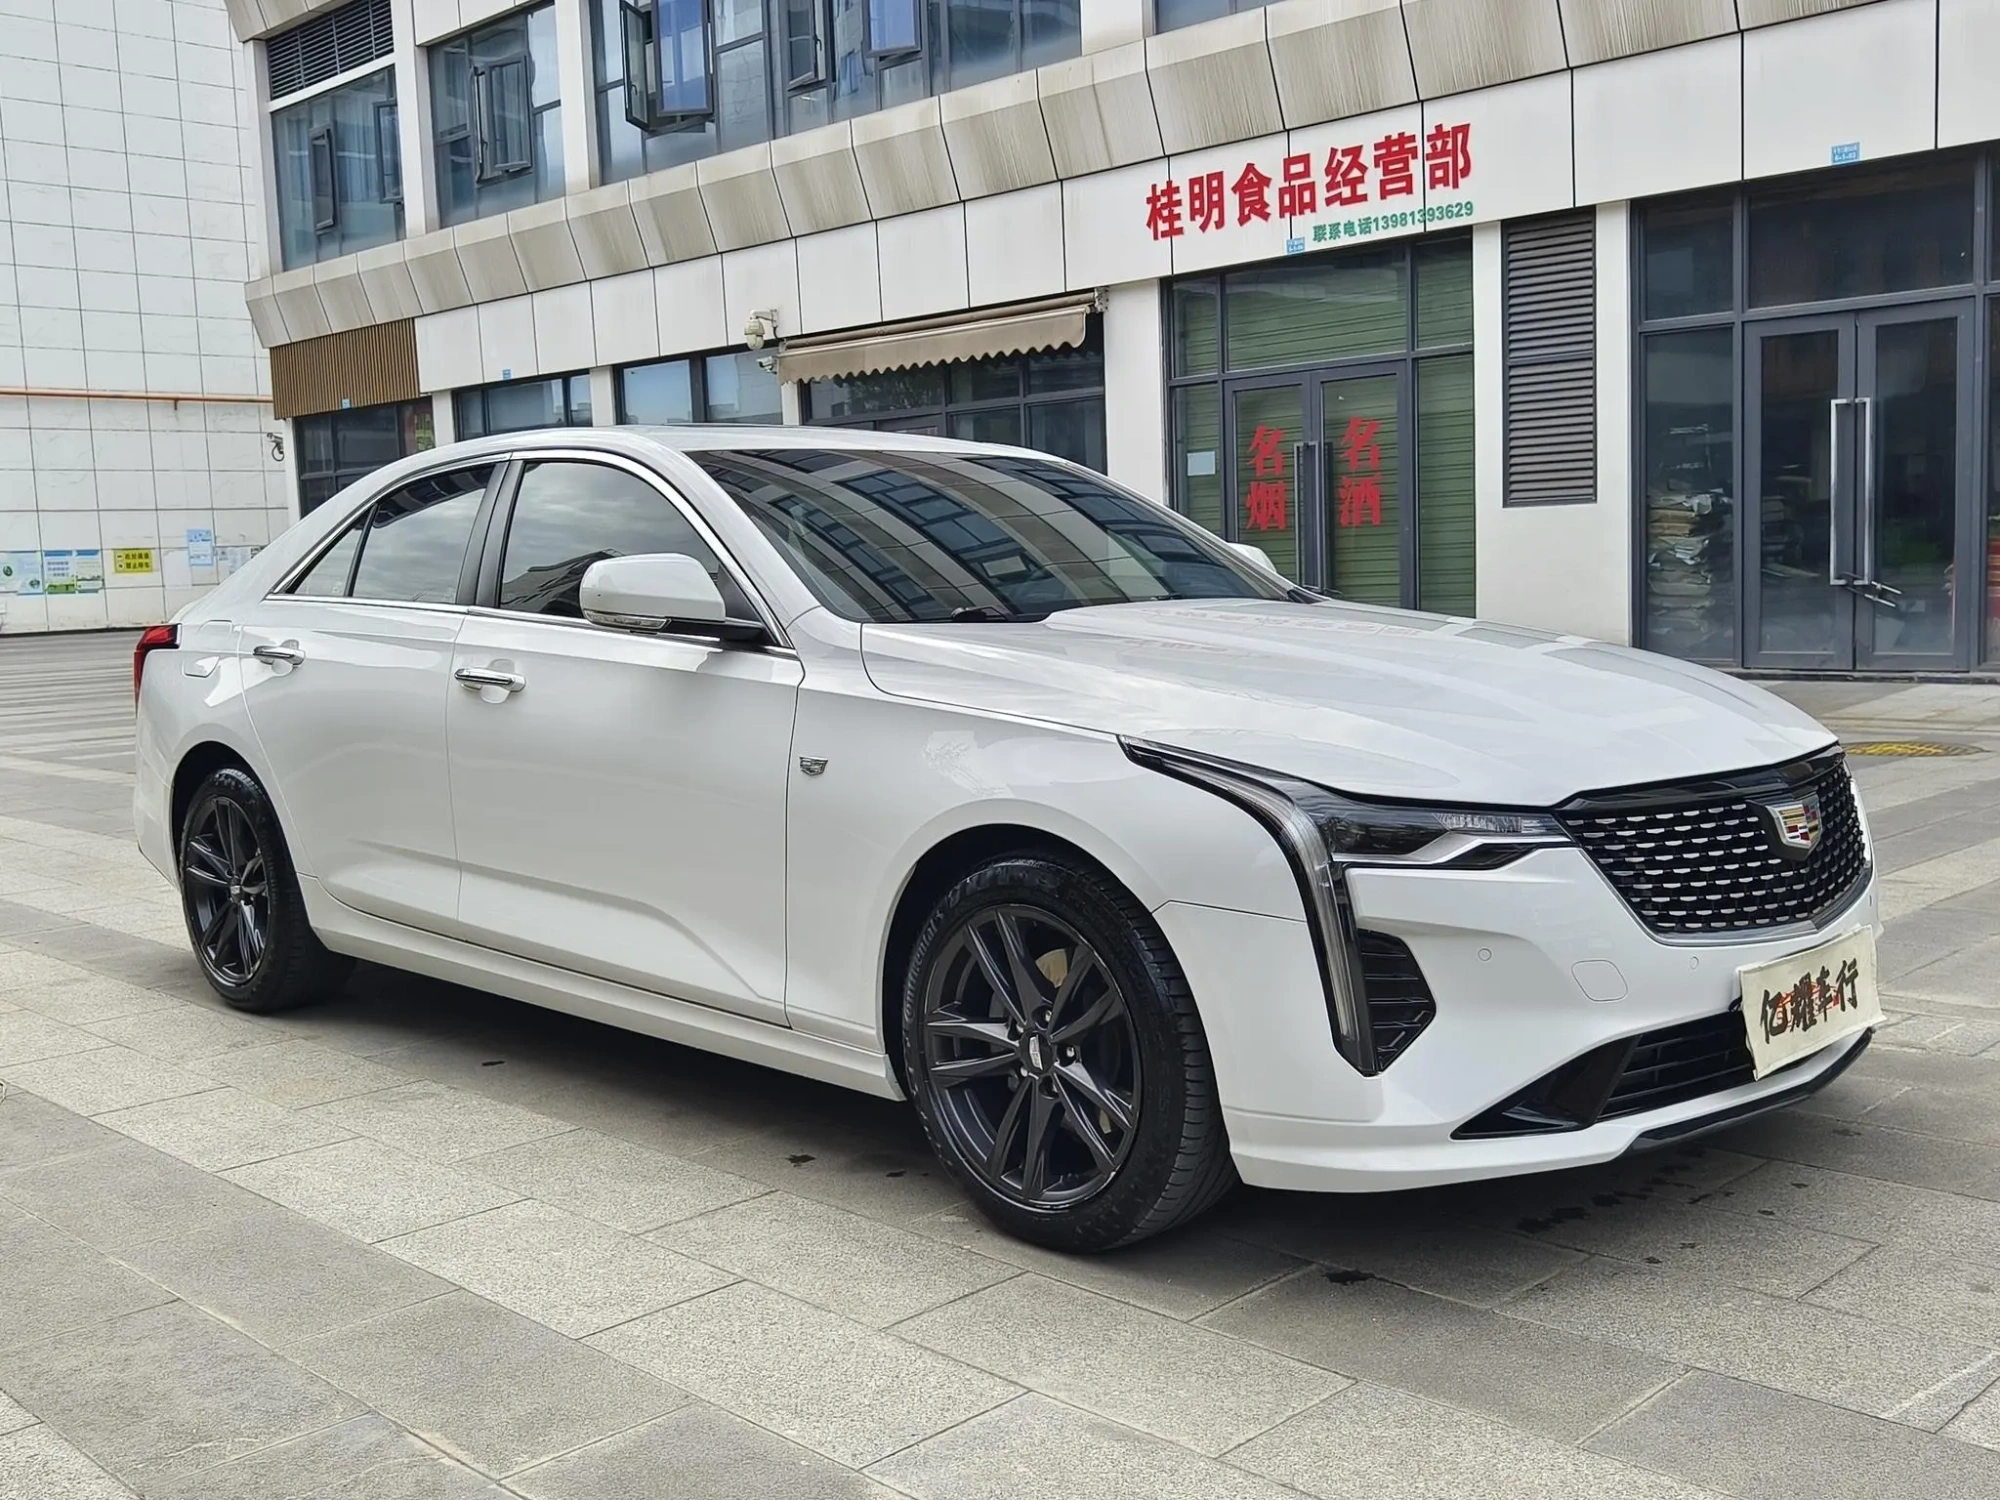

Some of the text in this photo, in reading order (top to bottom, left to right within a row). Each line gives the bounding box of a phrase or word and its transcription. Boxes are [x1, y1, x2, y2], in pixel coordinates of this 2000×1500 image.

[1146, 123, 1472, 240] 桂明食品经营部
[1312, 201, 1474, 243] 联系电话13981393629
[1245, 425, 1286, 531] 名烟
[1340, 417, 1383, 526] 名酒
